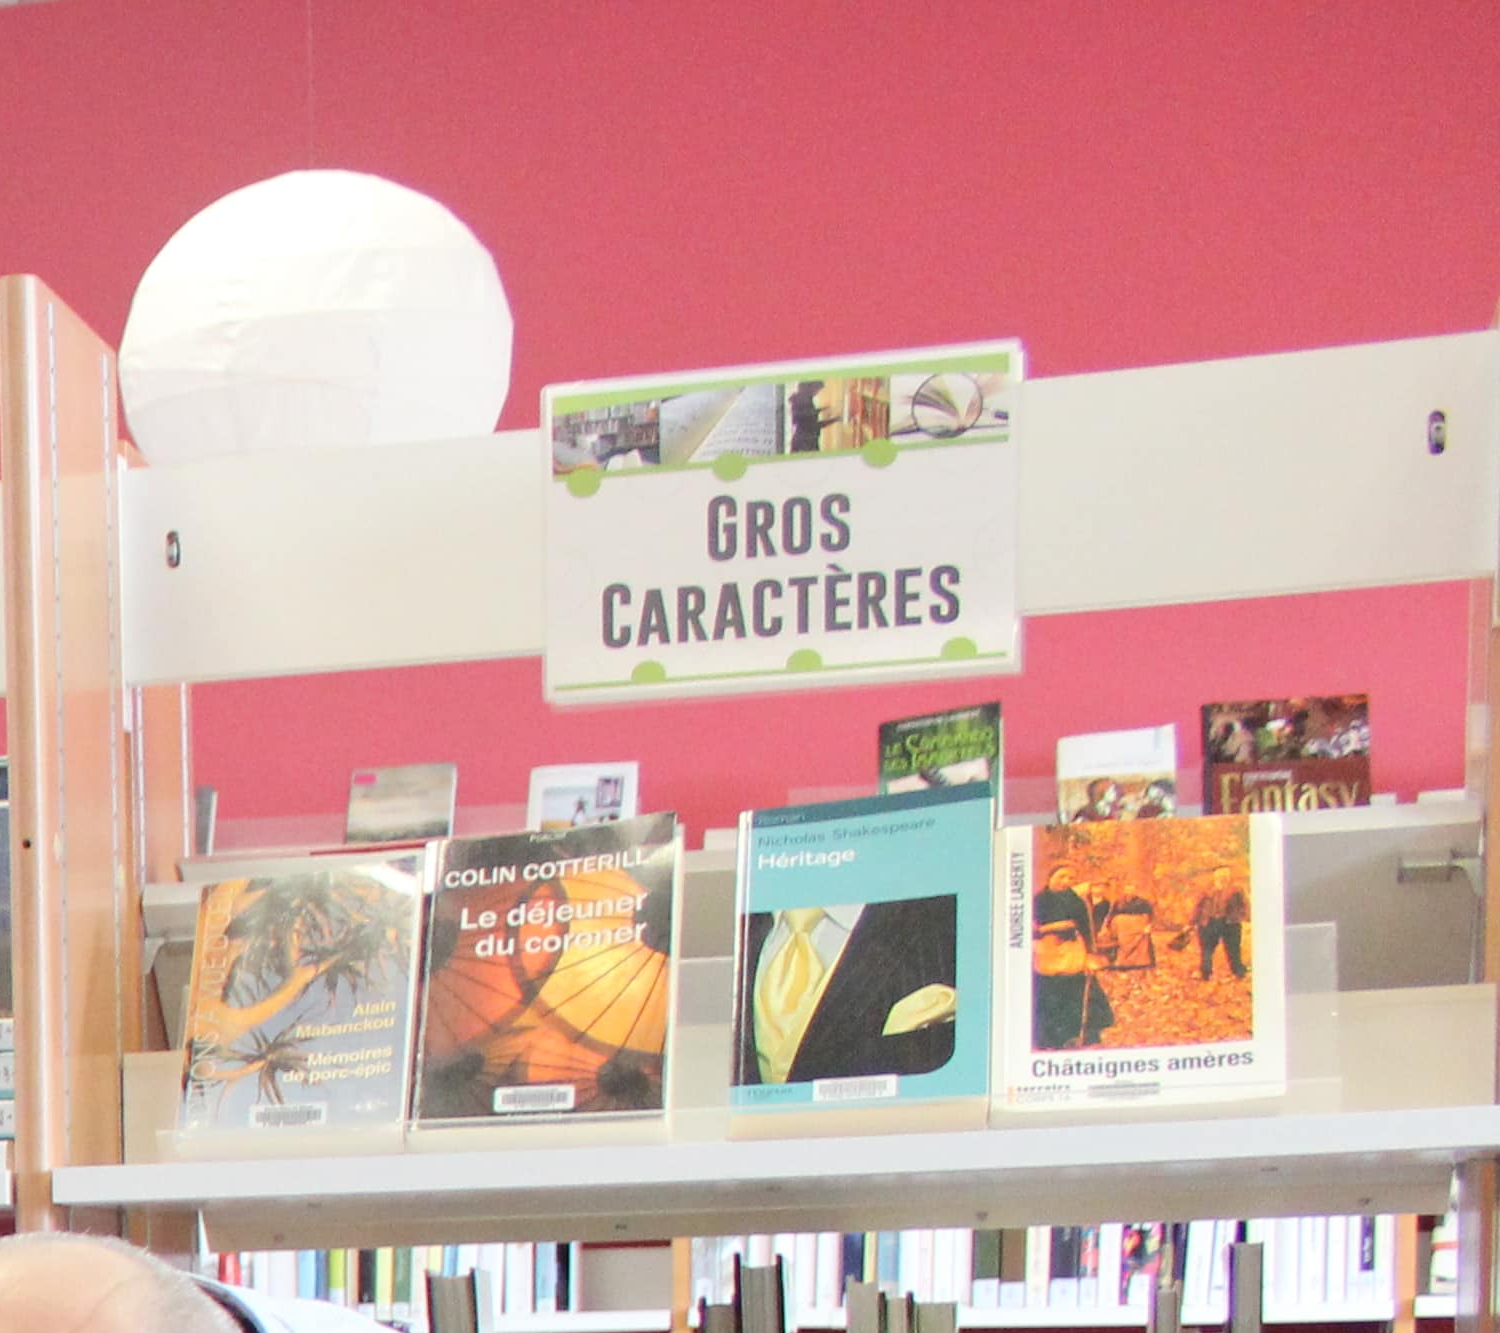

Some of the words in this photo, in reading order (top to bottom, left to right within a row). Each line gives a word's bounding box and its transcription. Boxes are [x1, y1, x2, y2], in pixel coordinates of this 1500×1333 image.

[706, 493, 852, 562] GROS
[602, 564, 962, 649] CARACTÈRES
[758, 830, 826, 848] Nicholas
[832, 818, 937, 841] Shakespeare
[444, 865, 517, 890] COLIN
[522, 849, 652, 882] COTTERILL
[757, 848, 857, 871] Héritage
[460, 907, 497, 932] Le
[506, 889, 648, 929] déjeuner
[475, 931, 514, 959] du
[524, 921, 648, 955] coroner
[352, 1001, 397, 1017] Alain
[307, 1045, 394, 1066] Mémoires
[1032, 1054, 1160, 1080] Châtaignes
[1167, 1048, 1255, 1070] amères
